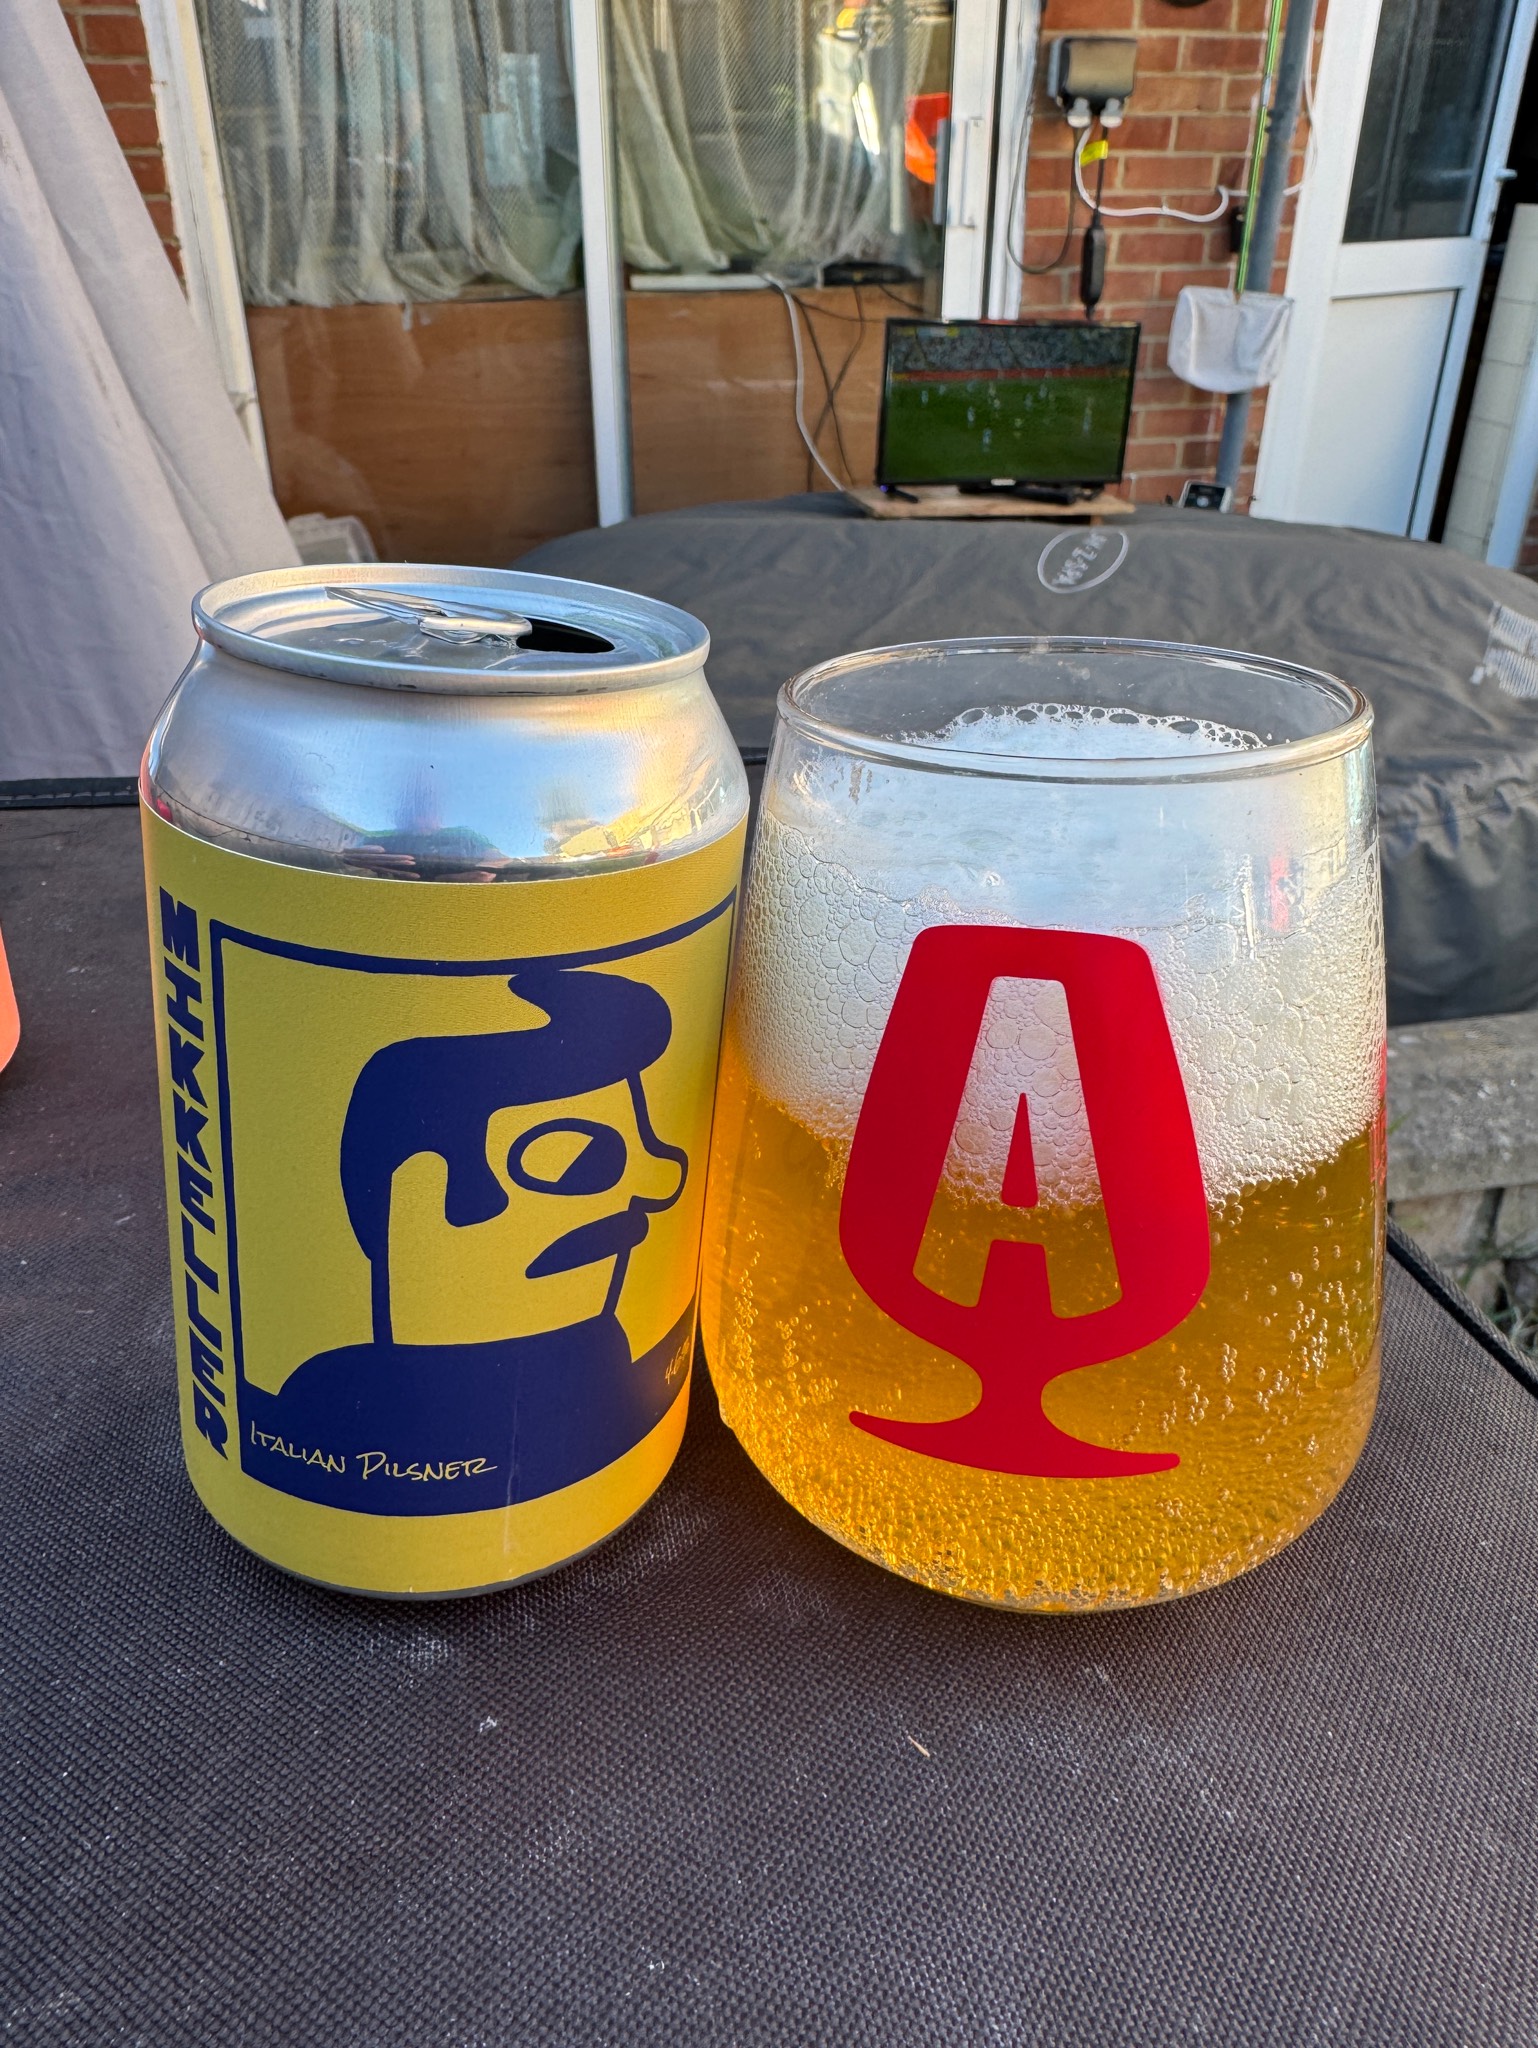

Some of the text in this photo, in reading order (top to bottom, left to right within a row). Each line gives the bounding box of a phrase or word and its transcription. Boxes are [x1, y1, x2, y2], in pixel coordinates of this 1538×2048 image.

[159, 885, 229, 1460] MIKKELLER
[251, 1421, 498, 1481] ITALIAN PILSNER
